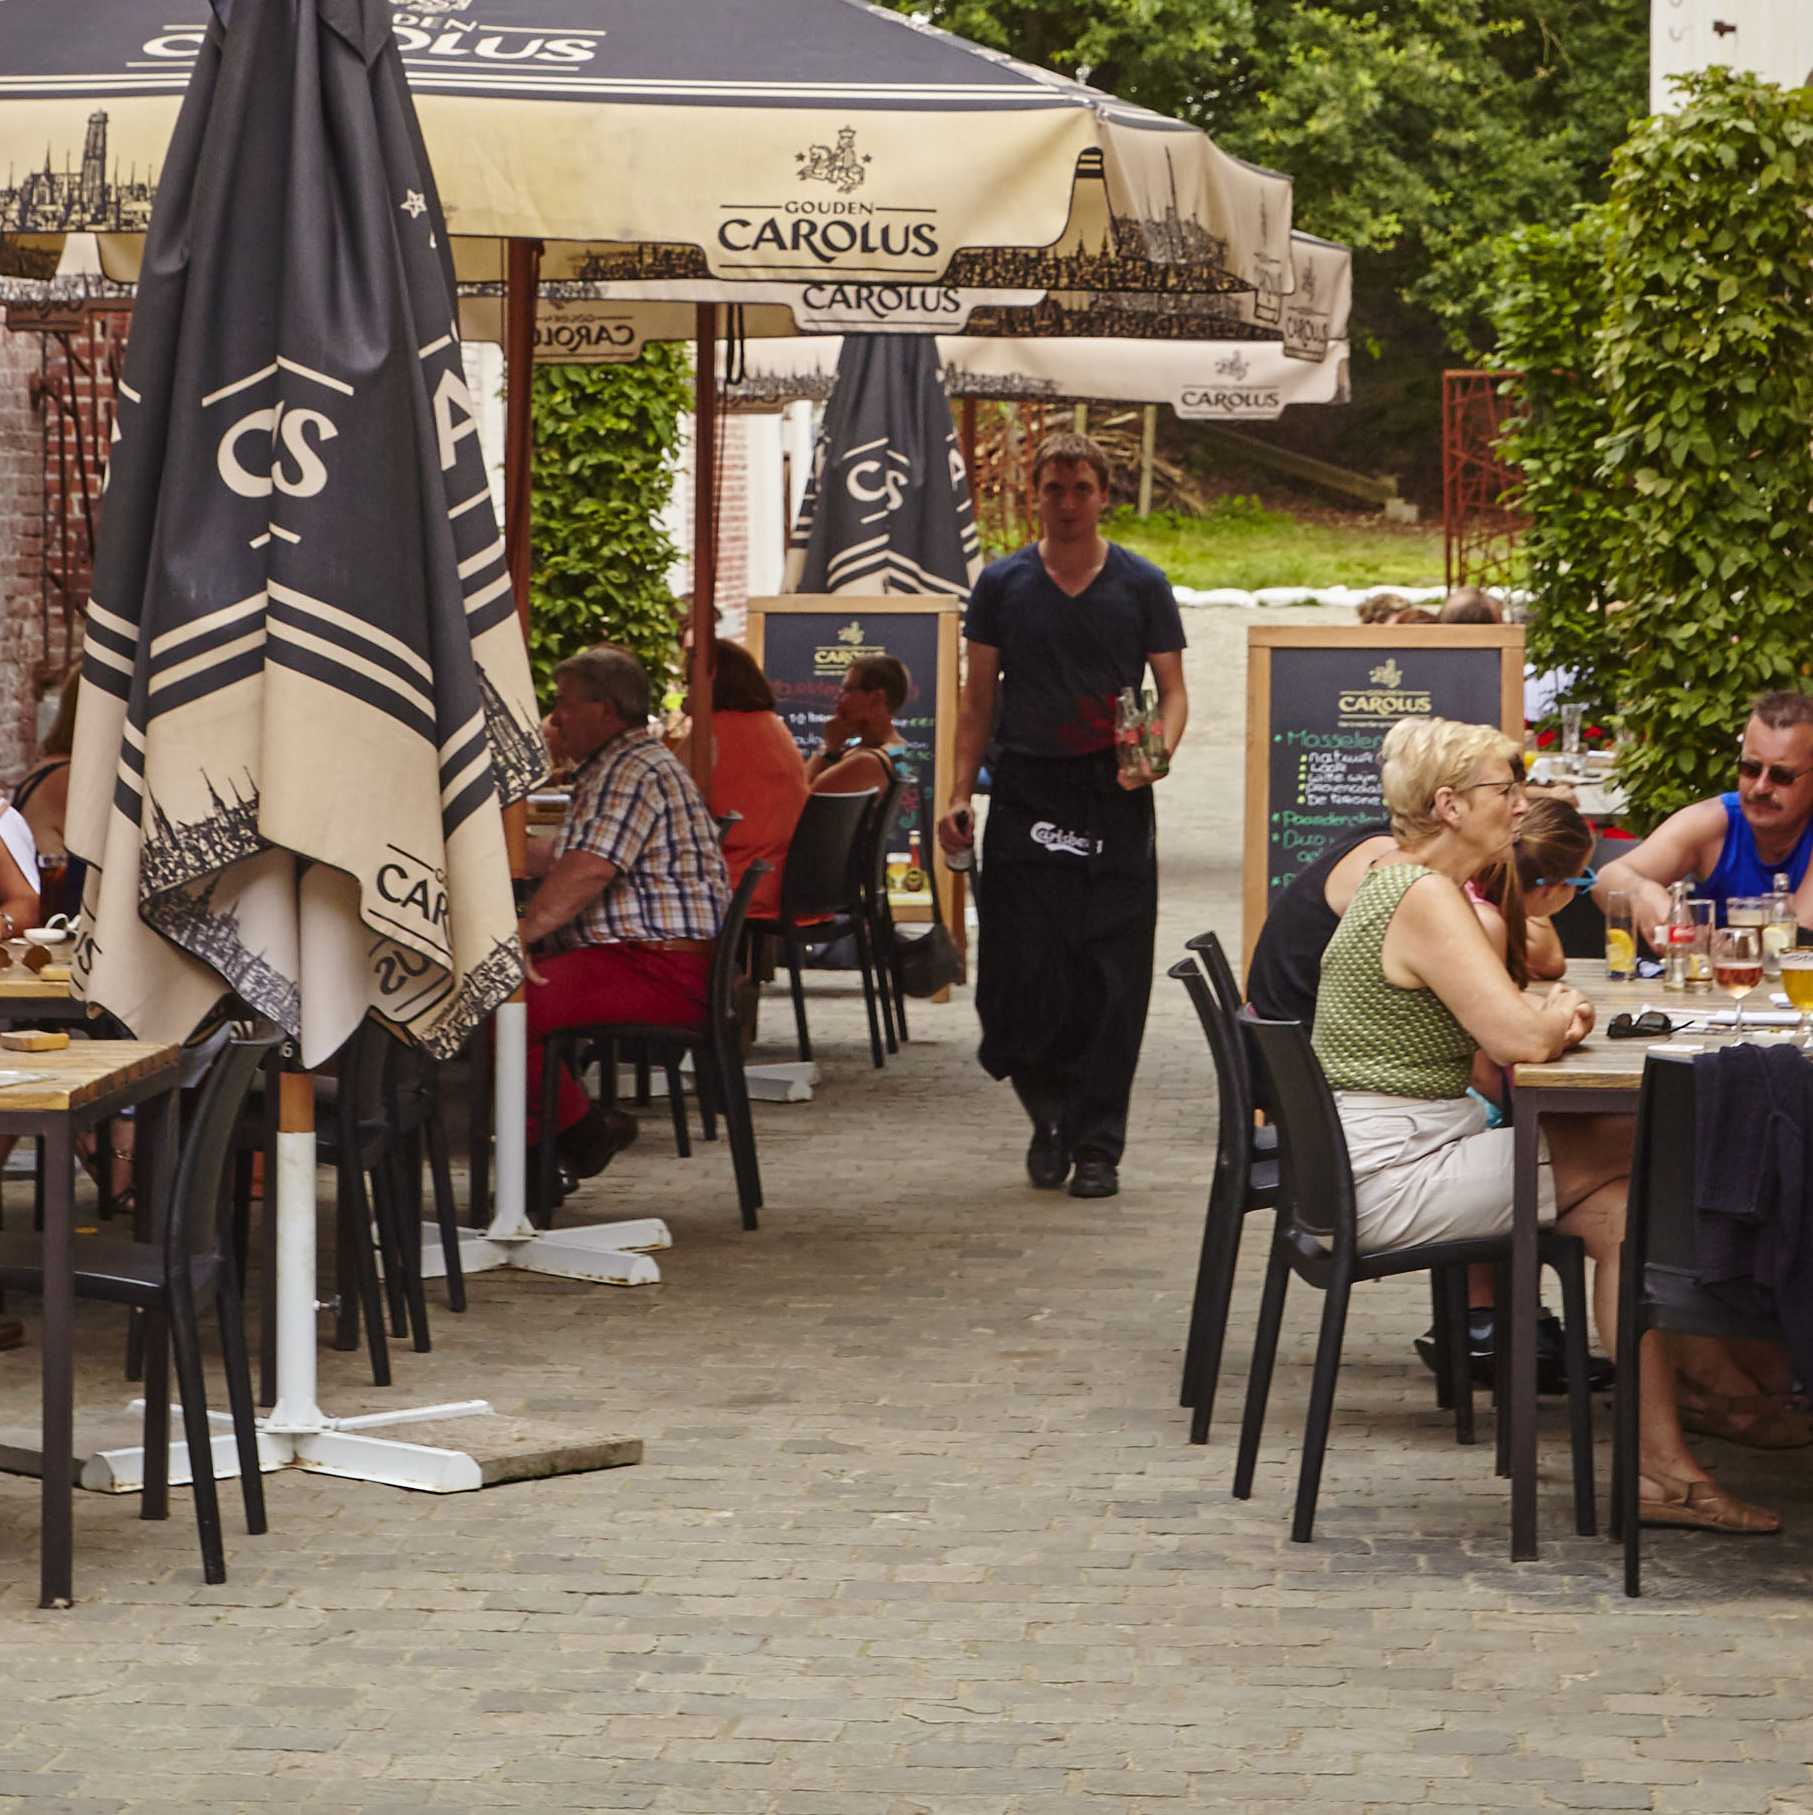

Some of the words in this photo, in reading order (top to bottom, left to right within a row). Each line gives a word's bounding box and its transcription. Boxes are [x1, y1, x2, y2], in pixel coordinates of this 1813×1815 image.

[142, 27, 599, 62] COLUS
[785, 201, 875, 216] GOUDEN
[718, 217, 938, 264] CAROLUS
[802, 285, 961, 319] CAROLUS
[1181, 390, 1280, 413] CAROLUS
[1338, 695, 1433, 716] CAROLUS
[281, 1041, 294, 1058] 6
